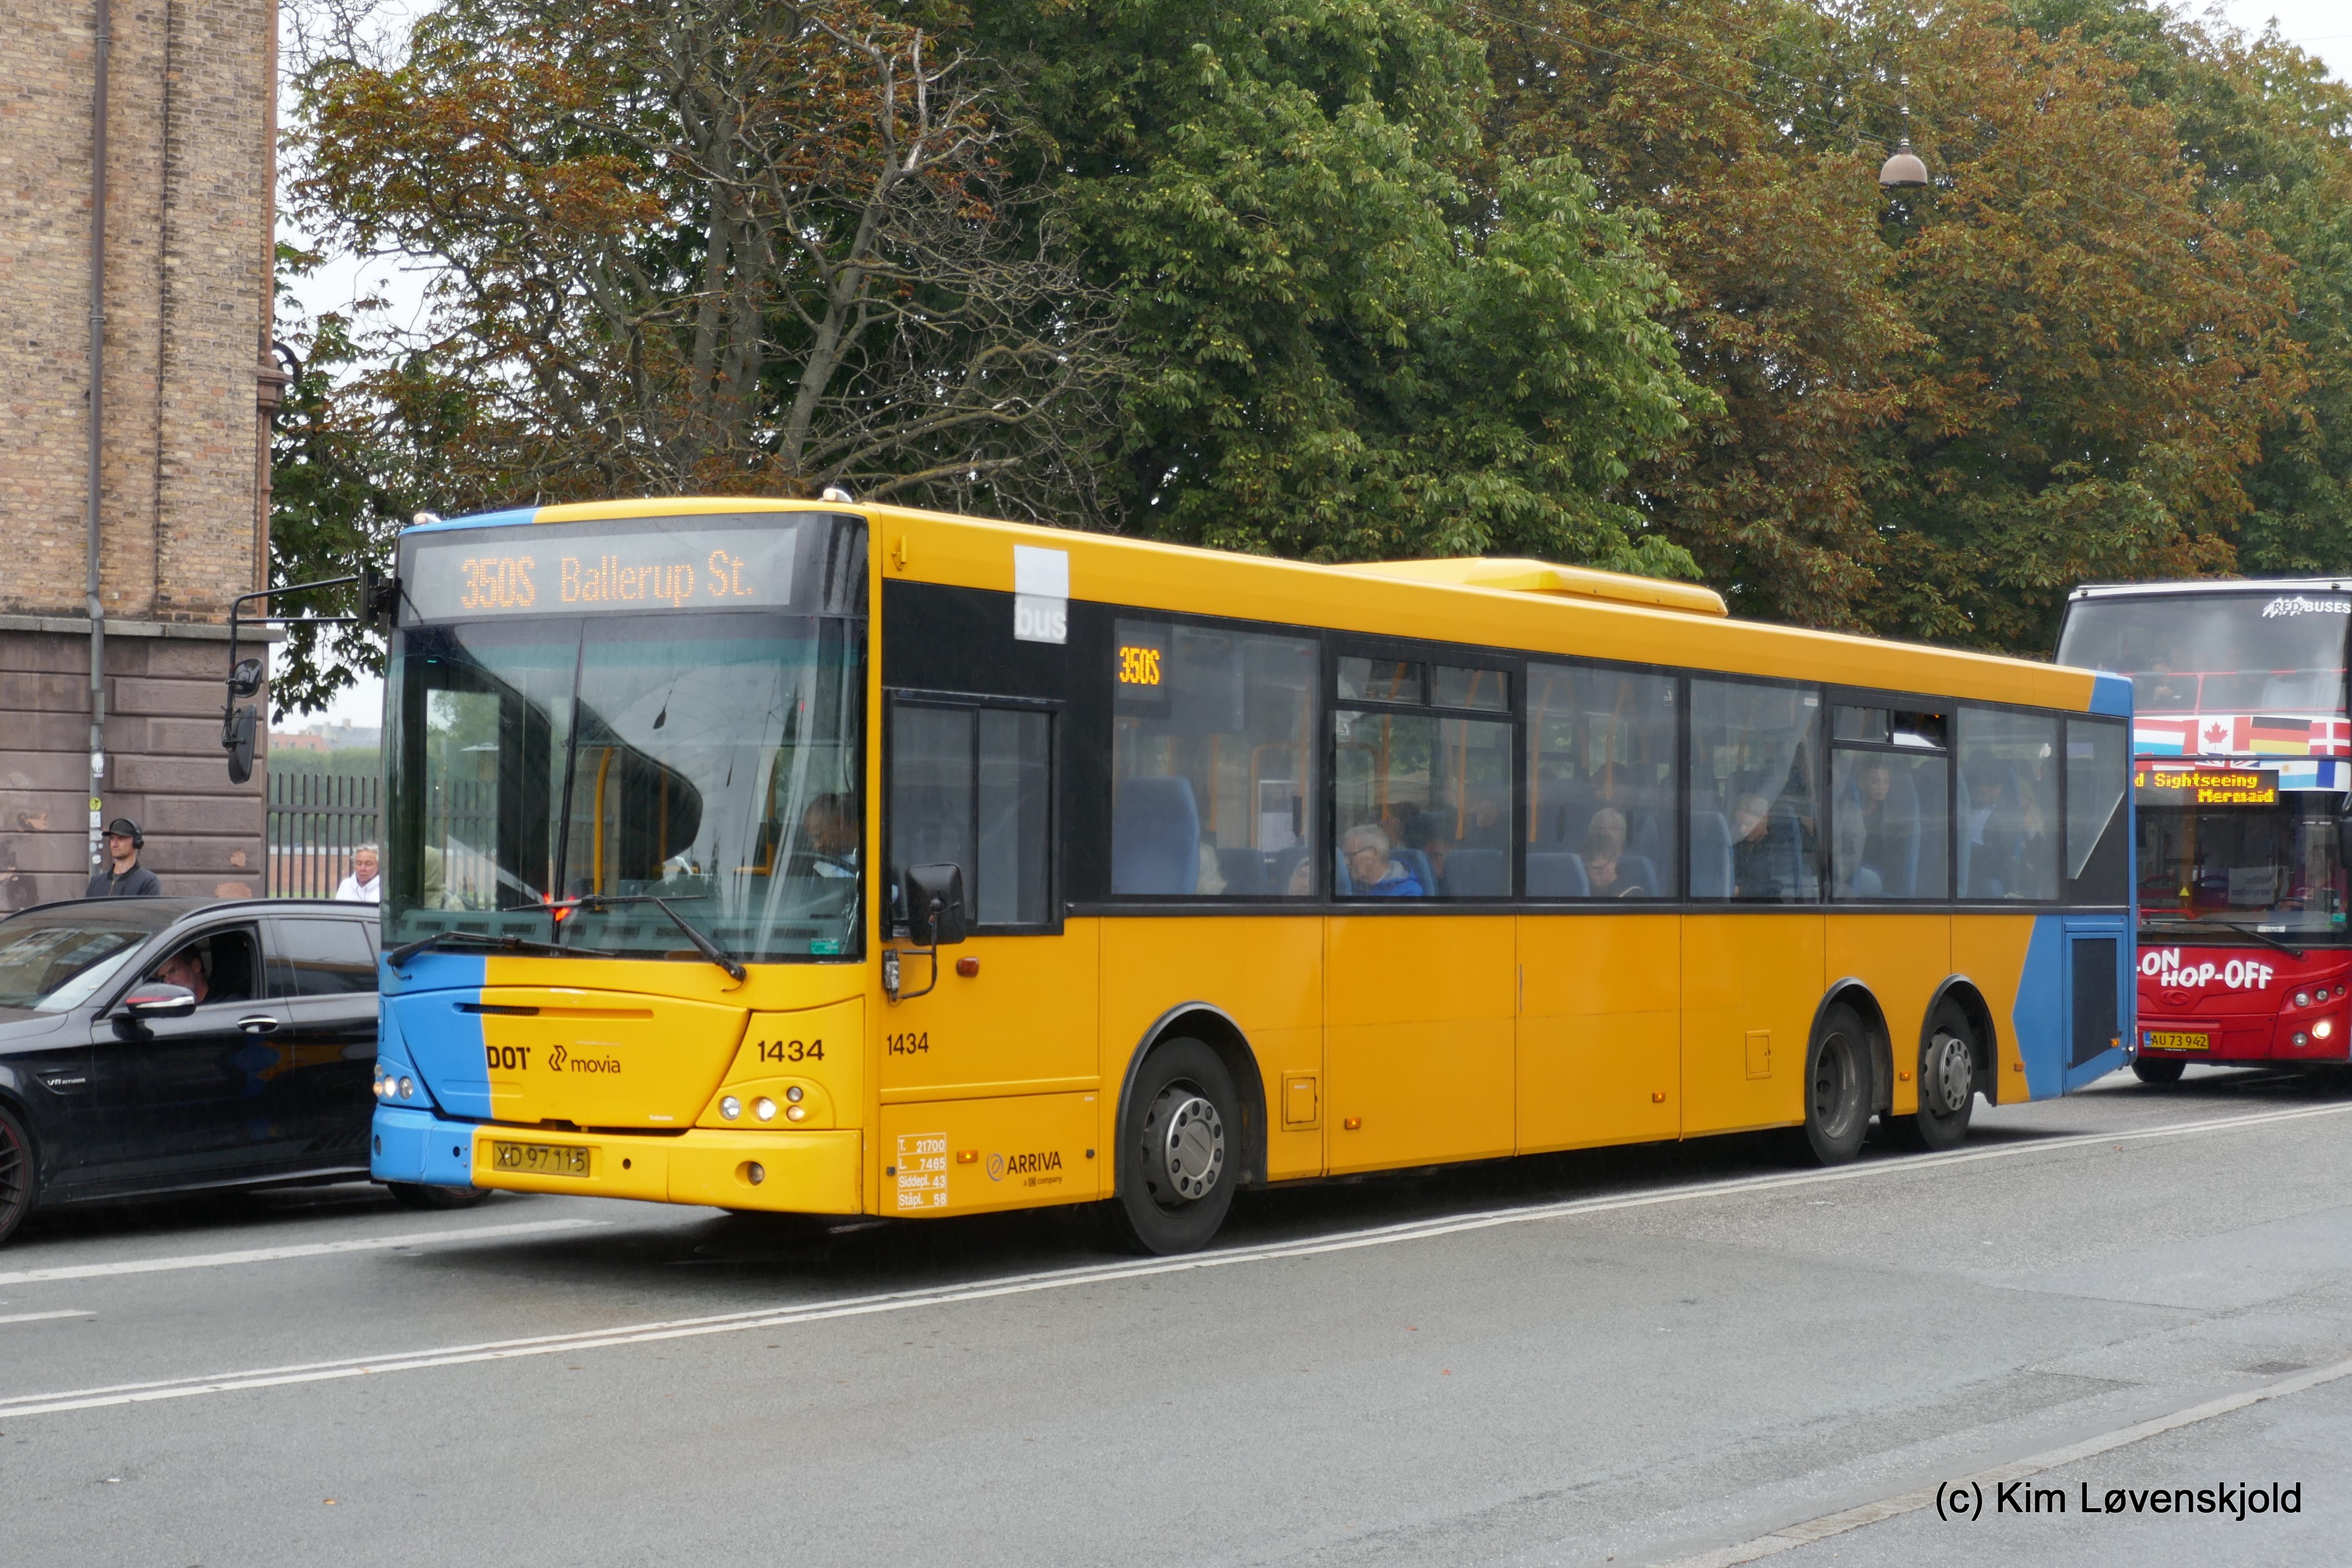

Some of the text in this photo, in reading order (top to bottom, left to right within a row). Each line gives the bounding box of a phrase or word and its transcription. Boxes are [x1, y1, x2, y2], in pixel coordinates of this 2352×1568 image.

[461, 550, 753, 609] 350S Ballerup St.
[1016, 597, 1068, 639] bus
[1119, 646, 1161, 685] 350S
[2154, 773, 2258, 789] Sightseeing
[2197, 789, 2274, 803] Mermaid
[2161, 960, 2274, 989] HOP-OFF
[758, 1039, 824, 1062] 1434
[887, 1032, 929, 1056] 1434
[2152, 1035, 2206, 1047] AU 73 942
[571, 1055, 620, 1073] movia
[899, 1139, 945, 1153] T. 21700
[497, 1147, 585, 1172] XD 97 115
[899, 1158, 946, 1170] L. 7465
[1007, 1152, 1062, 1175] ARRIVA
[899, 1174, 946, 1189] Siddepl. 43
[899, 1191, 946, 1208] Ståpl. 58
